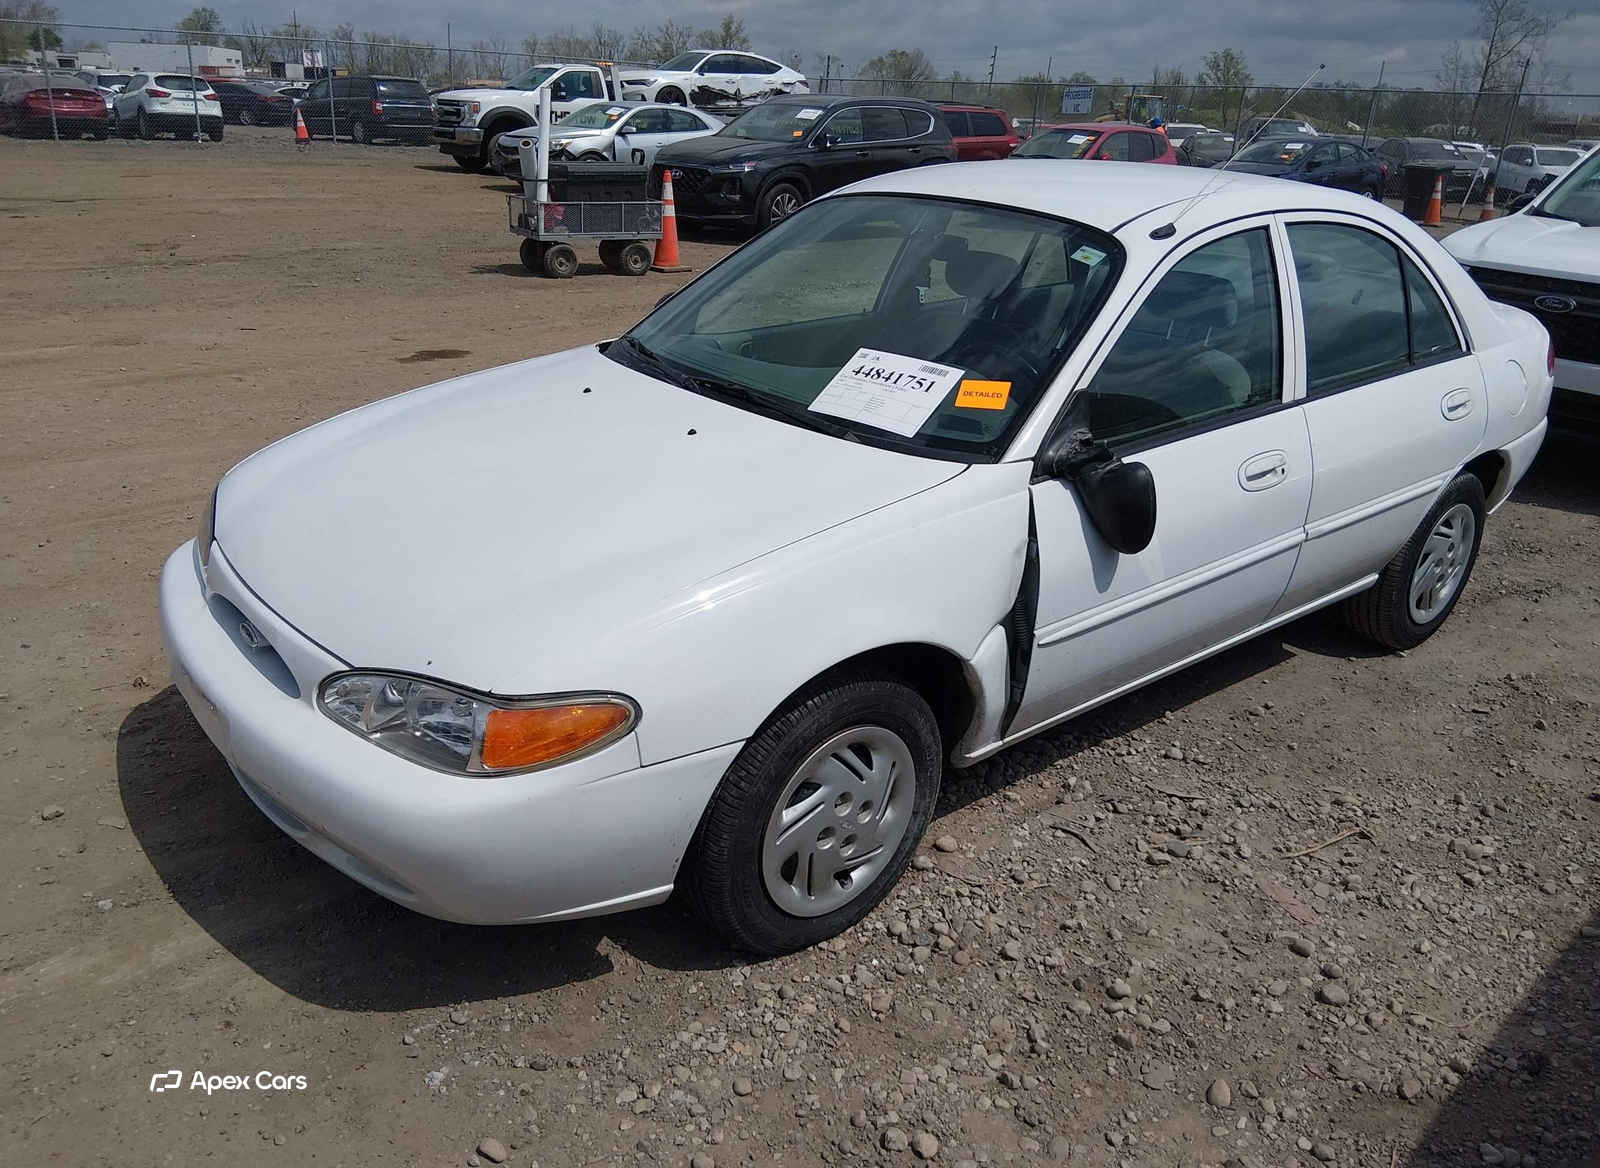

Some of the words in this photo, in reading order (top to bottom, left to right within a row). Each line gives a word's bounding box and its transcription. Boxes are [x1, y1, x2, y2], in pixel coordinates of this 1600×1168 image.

[1065, 89, 1092, 100] PROGRESSIVE
[851, 364, 936, 393] 44841751
[963, 390, 1003, 398] DETAILED
